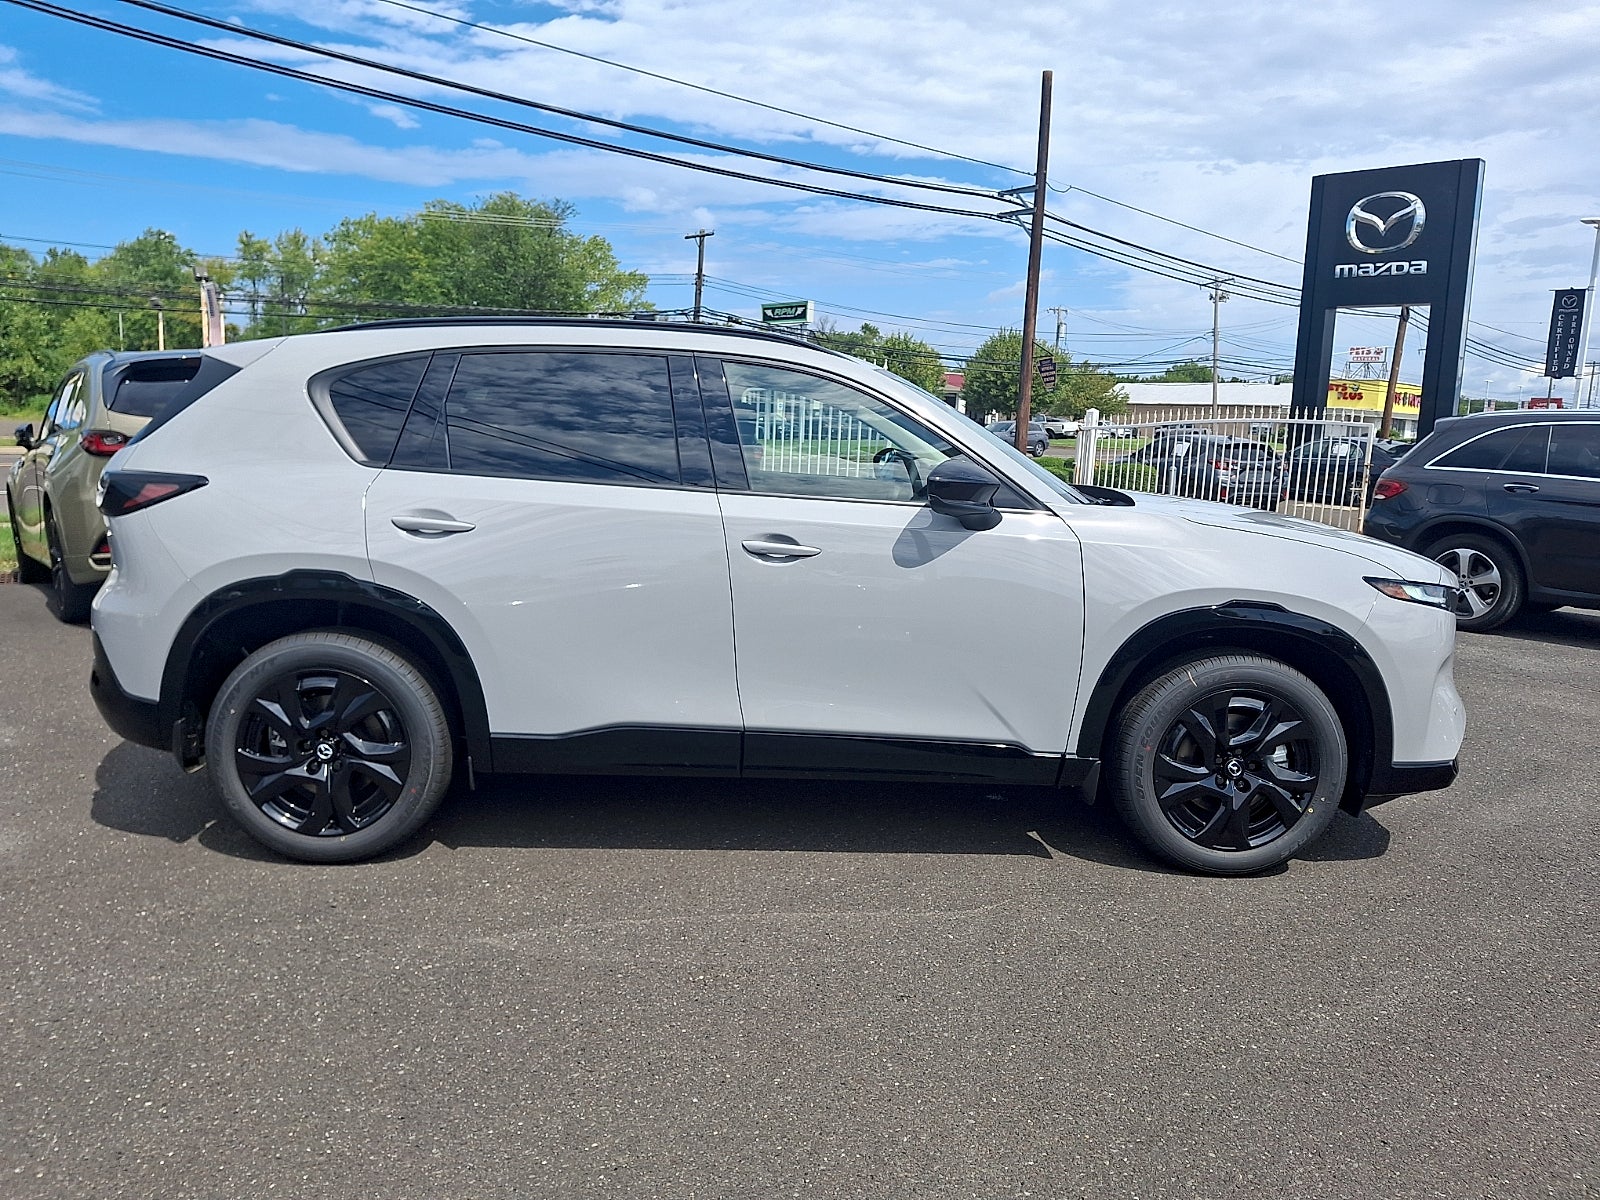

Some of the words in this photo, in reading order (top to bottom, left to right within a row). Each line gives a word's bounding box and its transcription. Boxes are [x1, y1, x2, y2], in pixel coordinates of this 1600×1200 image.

[774, 307, 796, 316] RPM
[1551, 314, 1565, 372] CERTIFIED
[1563, 337, 1575, 369] OWNED
[1328, 383, 1348, 391] ETS
[1337, 391, 1363, 400] PLUS
